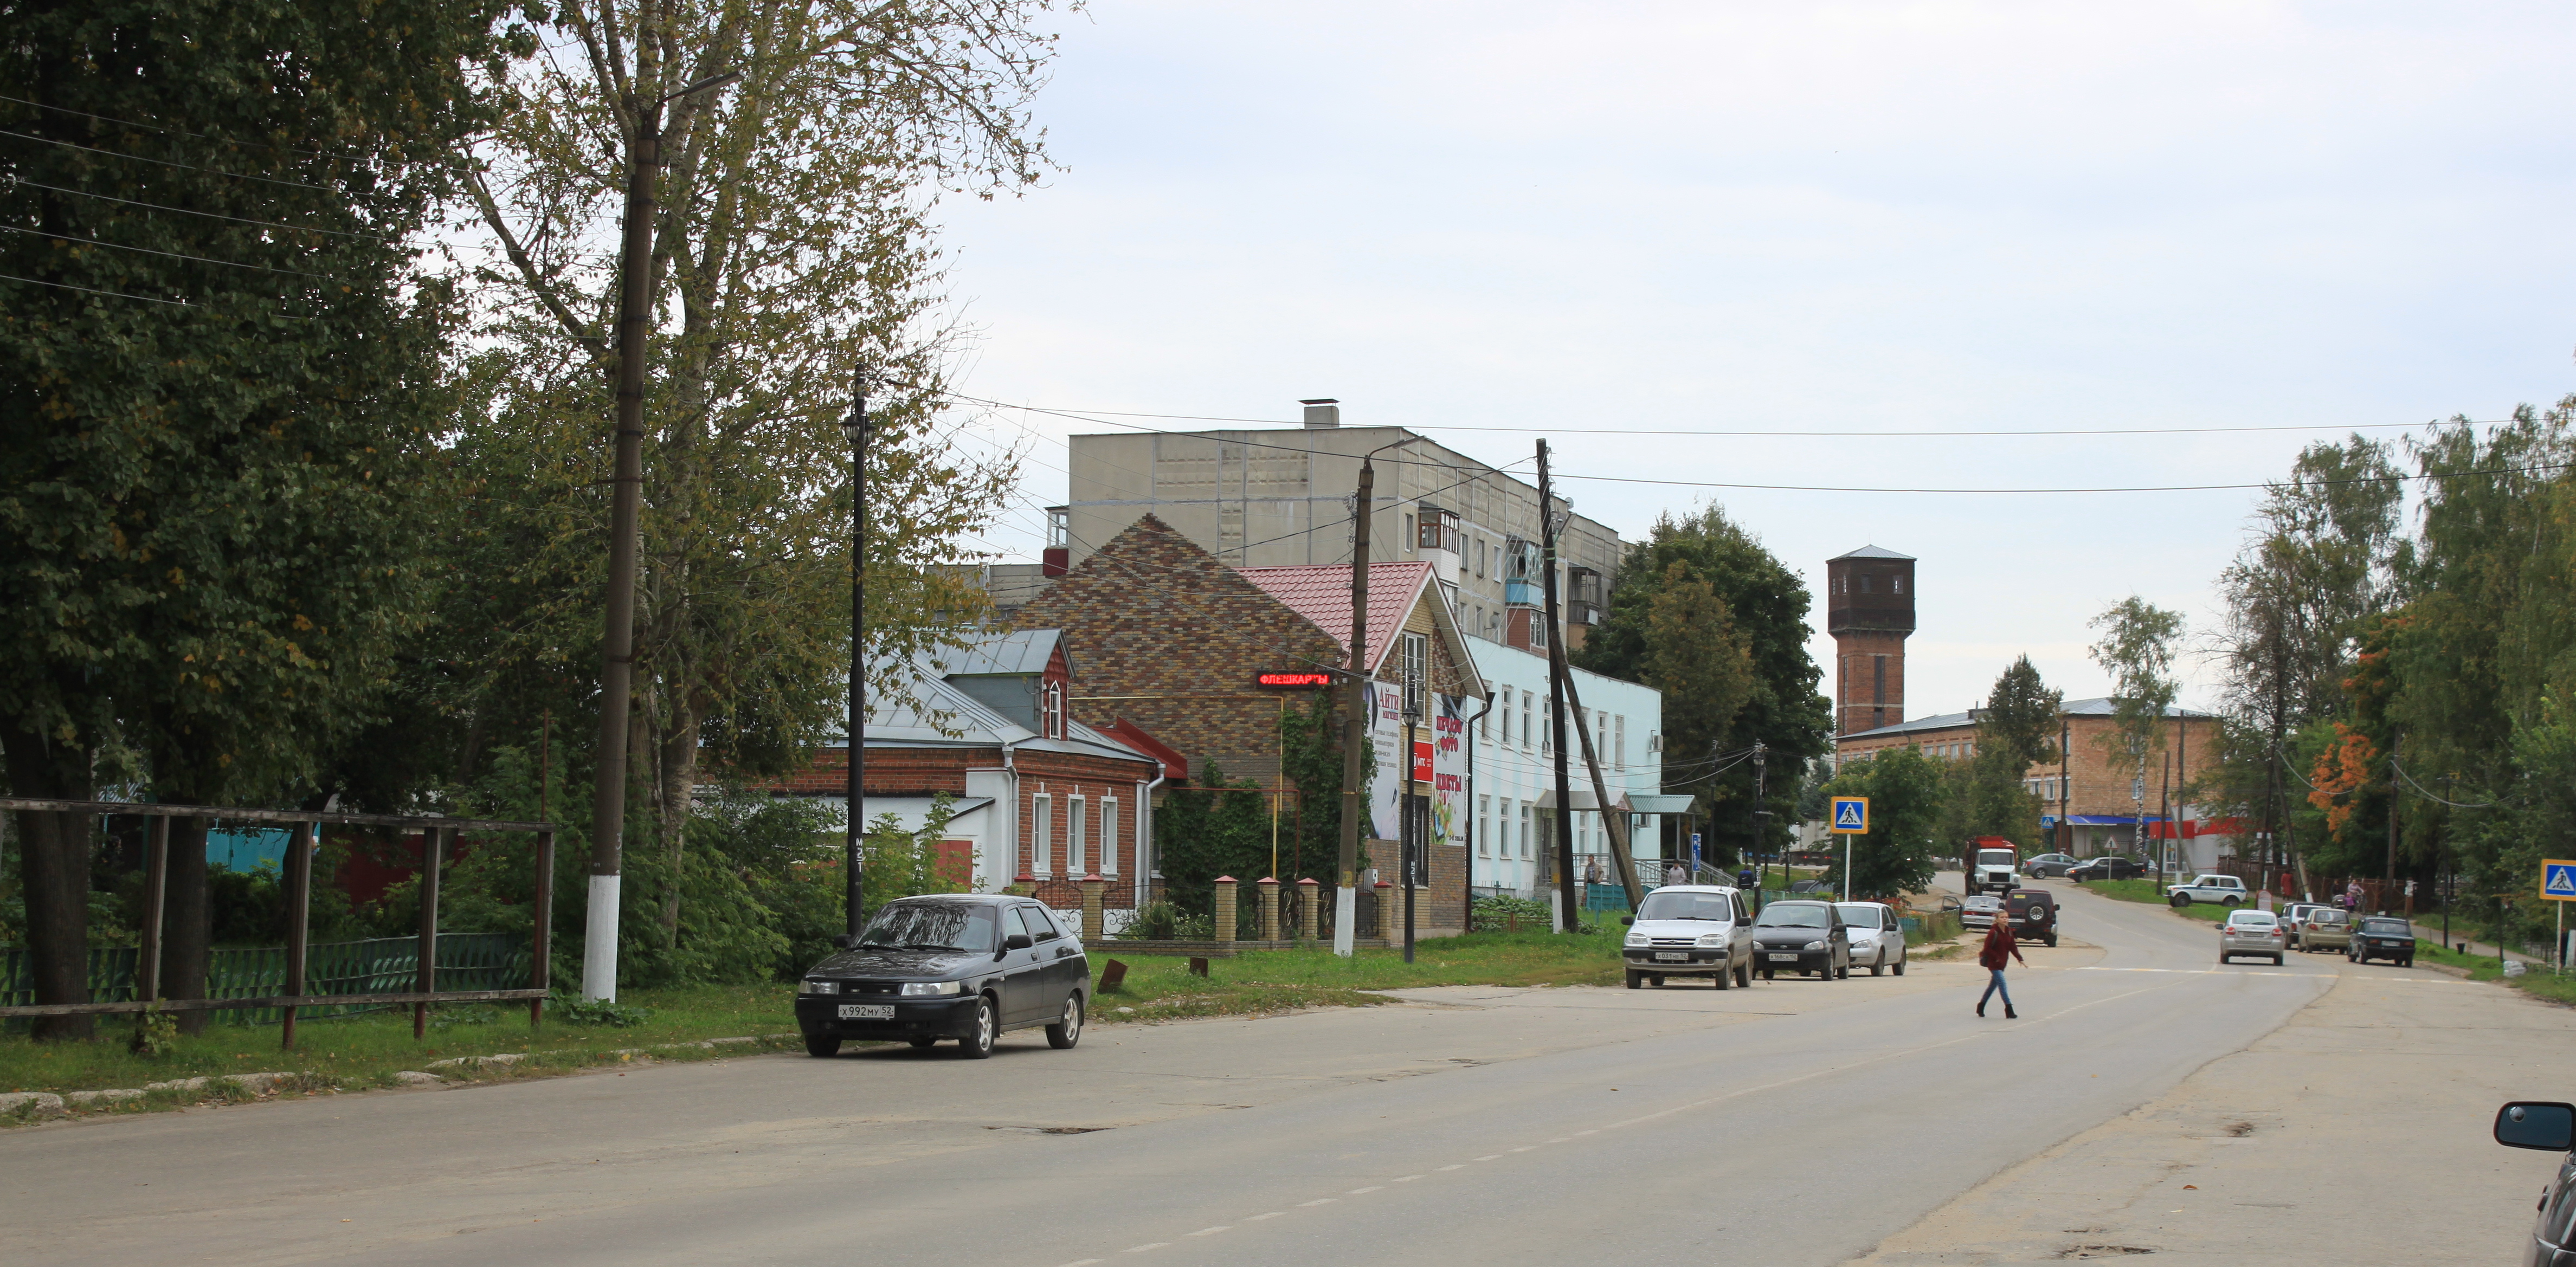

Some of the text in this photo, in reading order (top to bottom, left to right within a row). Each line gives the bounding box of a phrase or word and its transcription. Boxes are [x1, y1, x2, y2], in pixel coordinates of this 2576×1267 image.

[1440, 735, 1459, 752] ФОТО
[1418, 757, 1426, 767] МТС
[1436, 773, 1462, 792] ЦВЕТЫ
[842, 1006, 879, 1016] Х992МУ
